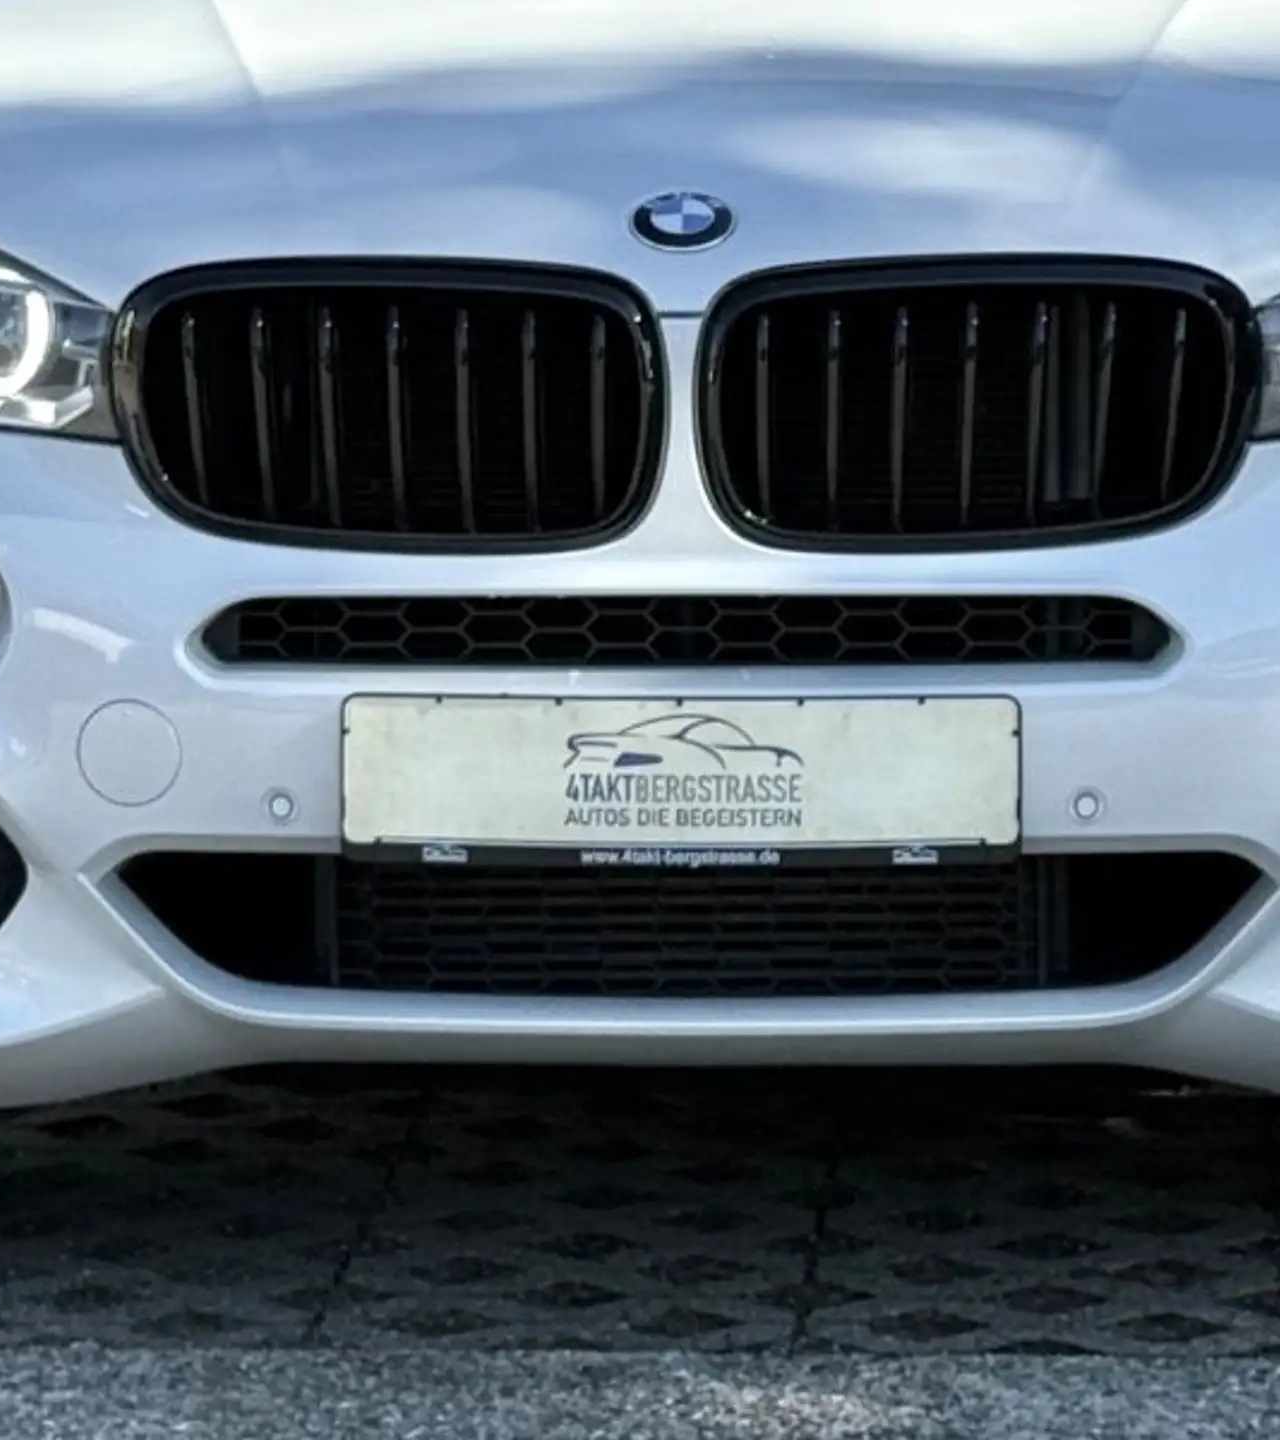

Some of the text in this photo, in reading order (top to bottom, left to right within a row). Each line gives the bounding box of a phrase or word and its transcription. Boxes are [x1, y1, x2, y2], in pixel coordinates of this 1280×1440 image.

[565, 772, 803, 804] 4TAKTBERGSTRASSE
[564, 808, 802, 828] AUTOS DIE BEGEISTERN
